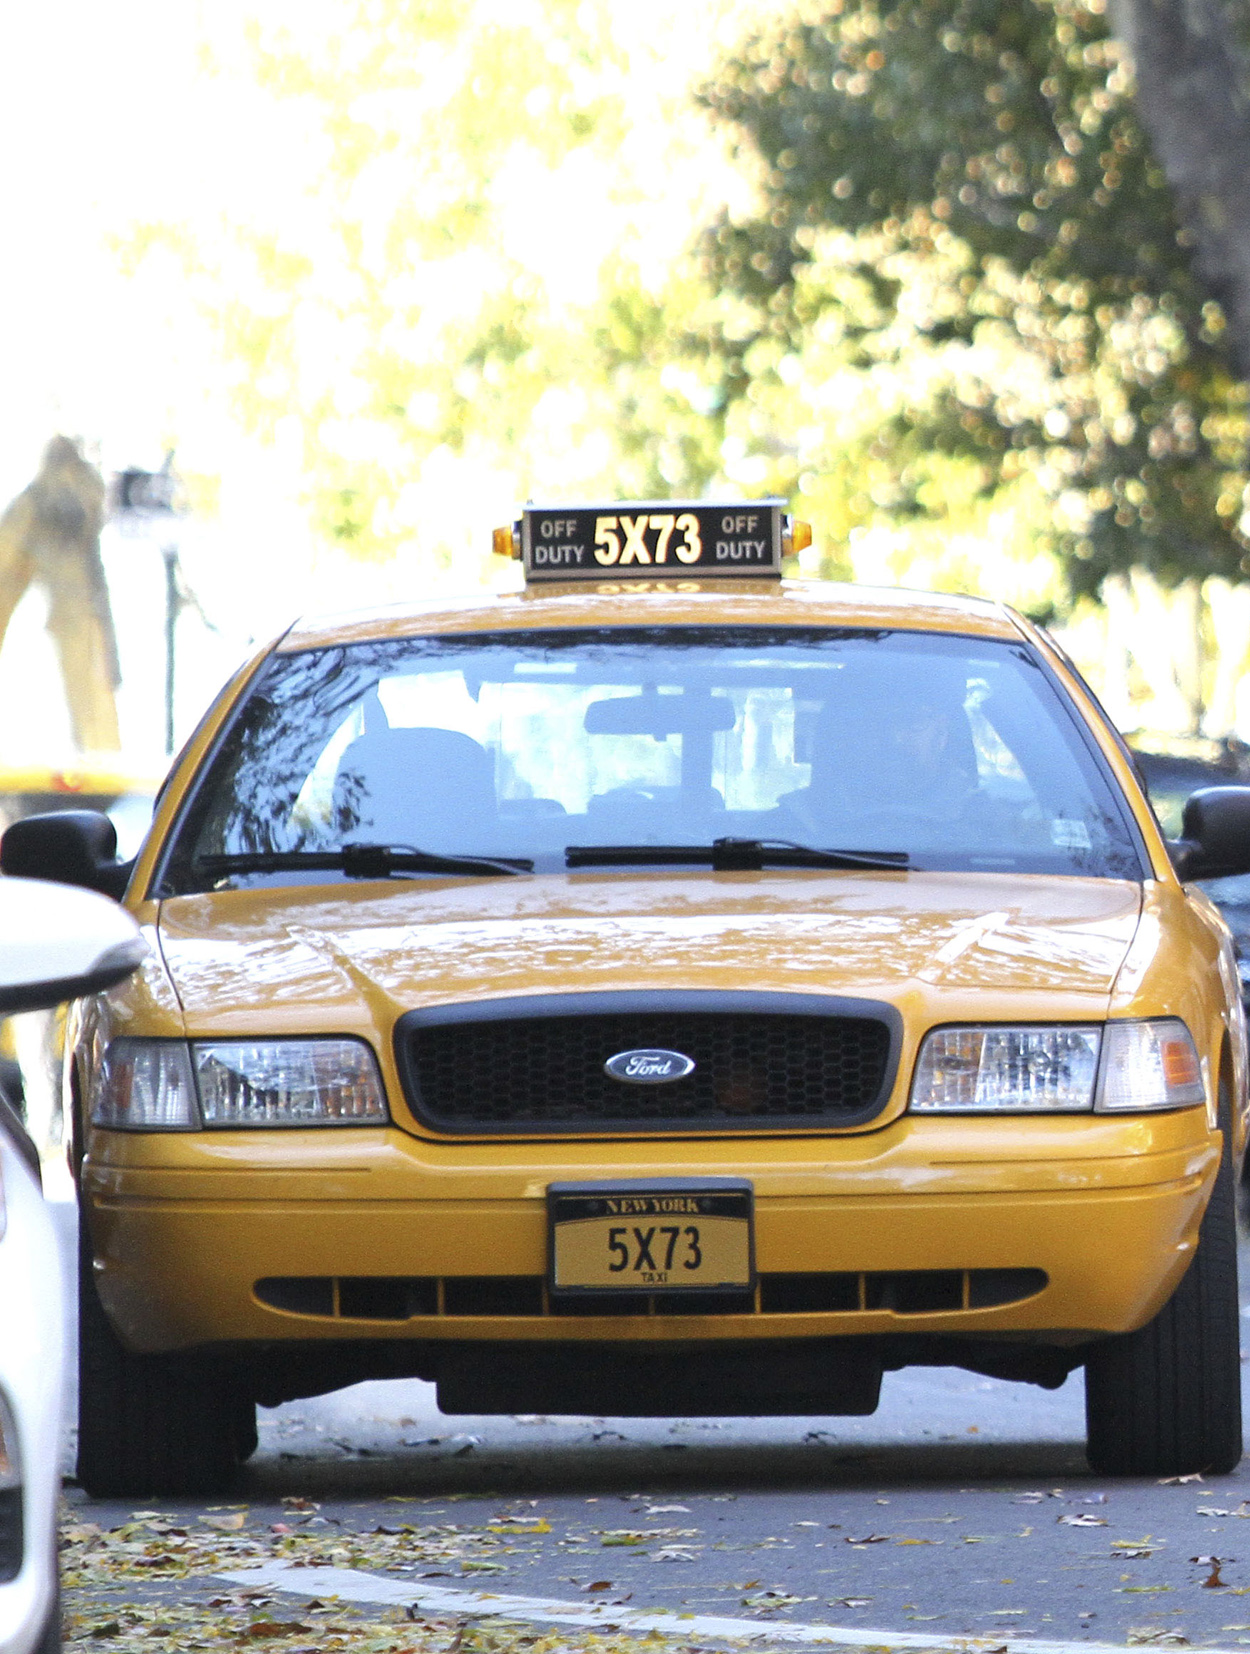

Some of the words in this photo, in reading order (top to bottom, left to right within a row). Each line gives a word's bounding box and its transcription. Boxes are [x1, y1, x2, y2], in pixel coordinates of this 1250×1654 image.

[540, 519, 577, 539] OFF
[721, 515, 758, 534] OFF
[593, 513, 702, 566] 5X73
[534, 545, 585, 564] DUTY
[715, 541, 766, 560] DUTY
[625, 1056, 672, 1076] Ford
[606, 1200, 649, 1214] NEW
[652, 1199, 699, 1213] YORK
[608, 1226, 702, 1272] 5X73
